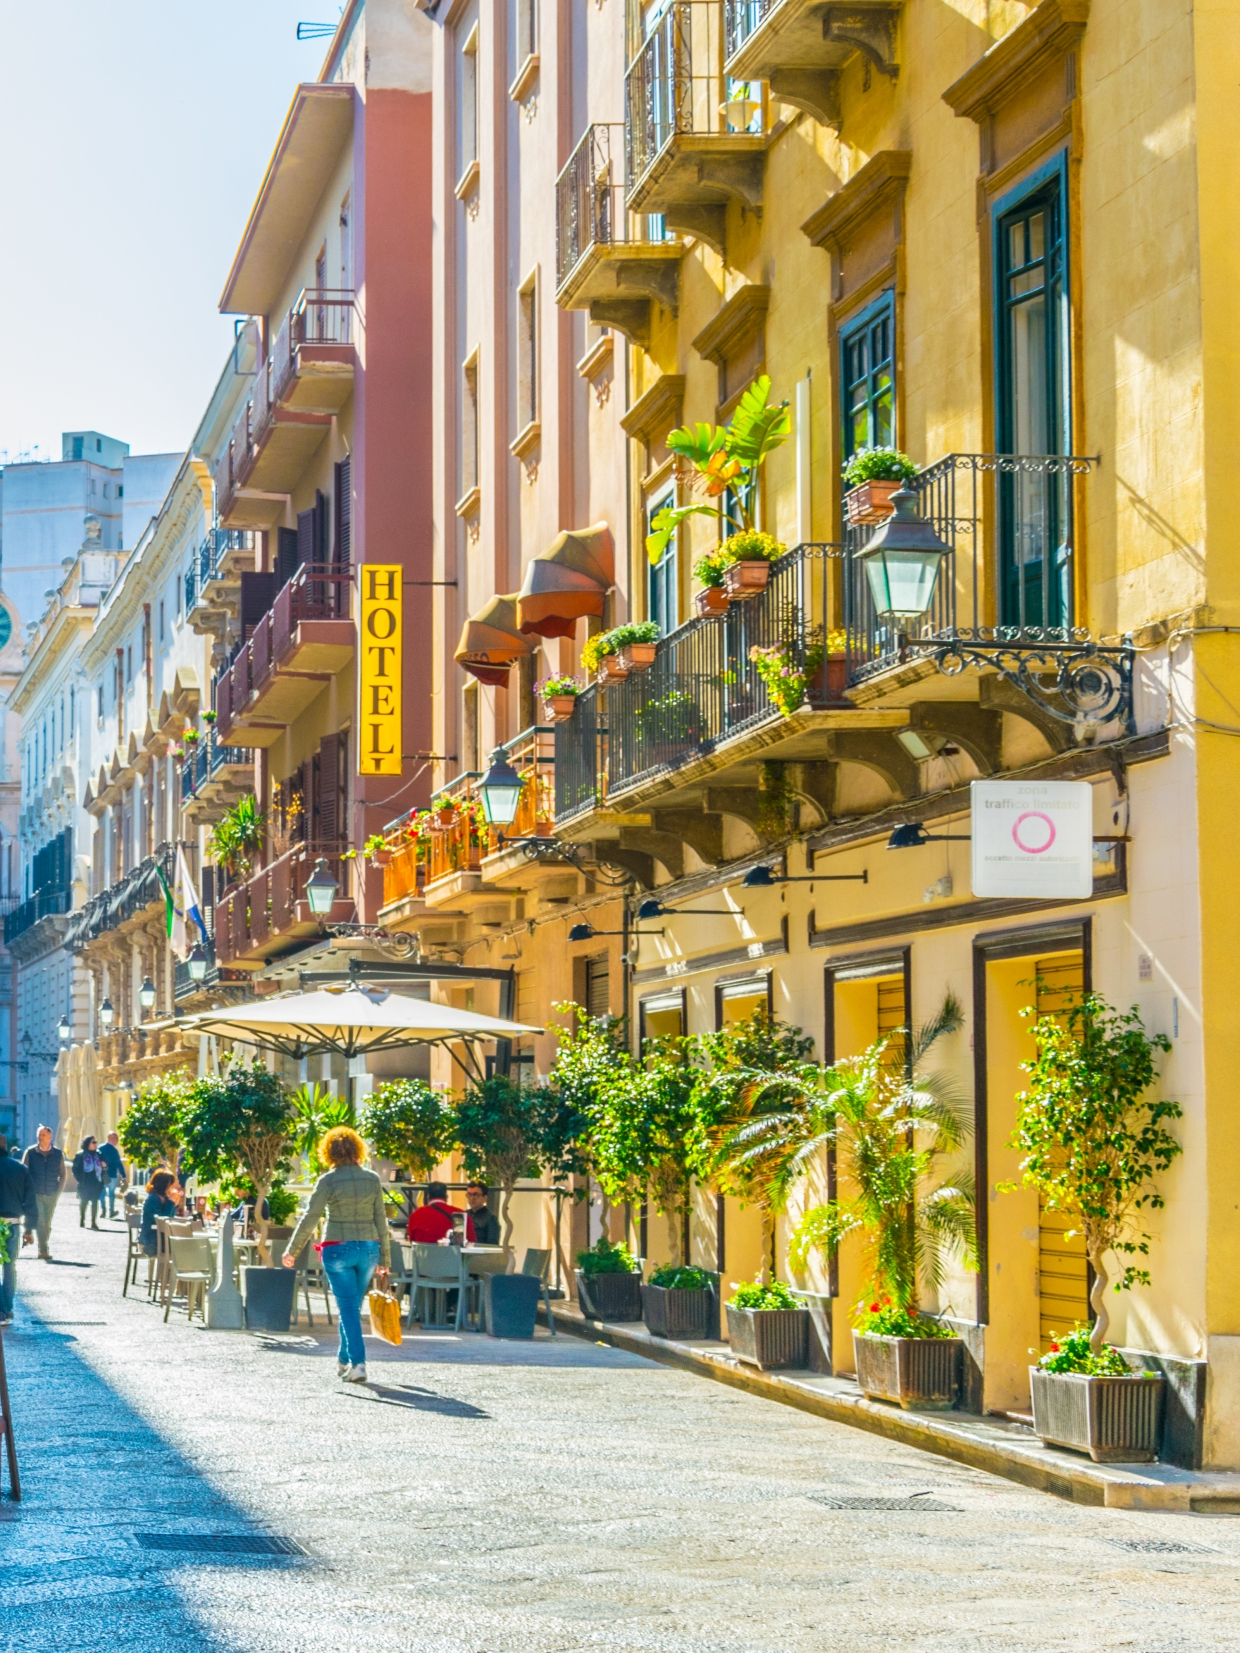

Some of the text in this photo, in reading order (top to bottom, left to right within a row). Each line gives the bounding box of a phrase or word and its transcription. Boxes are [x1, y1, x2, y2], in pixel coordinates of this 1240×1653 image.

[366, 570, 399, 754] HOTEL
[1017, 786, 1047, 795] zona
[985, 799, 1080, 809] traffico limitato
